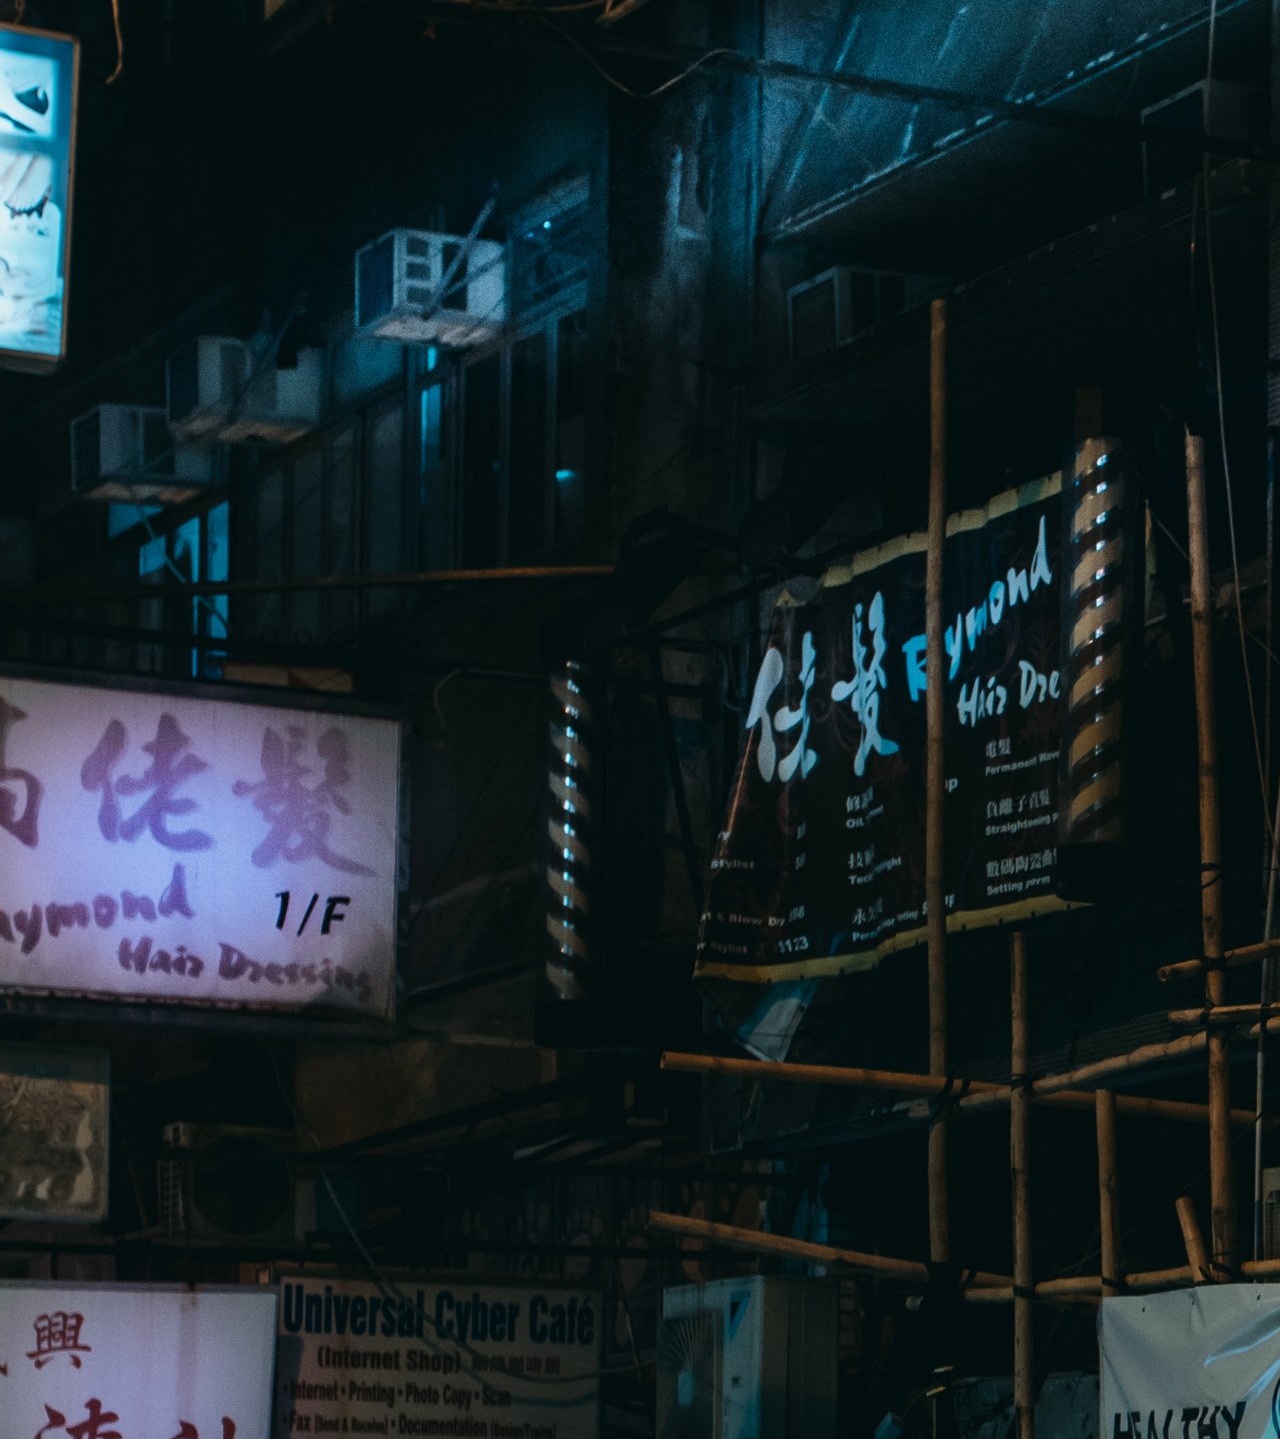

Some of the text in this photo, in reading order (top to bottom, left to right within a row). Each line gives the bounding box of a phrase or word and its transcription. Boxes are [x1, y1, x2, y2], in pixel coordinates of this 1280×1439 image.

[273, 890, 351, 937] 1/F
[283, 1283, 595, 1345] Universal Cyber Café
[317, 1345, 401, 1372] (Internet
[405, 1349, 462, 1374] Shop)
[289, 1379, 512, 1411] Internet Printing Photo Copy Scan
[289, 1410, 487, 1438] Fax Documentation
